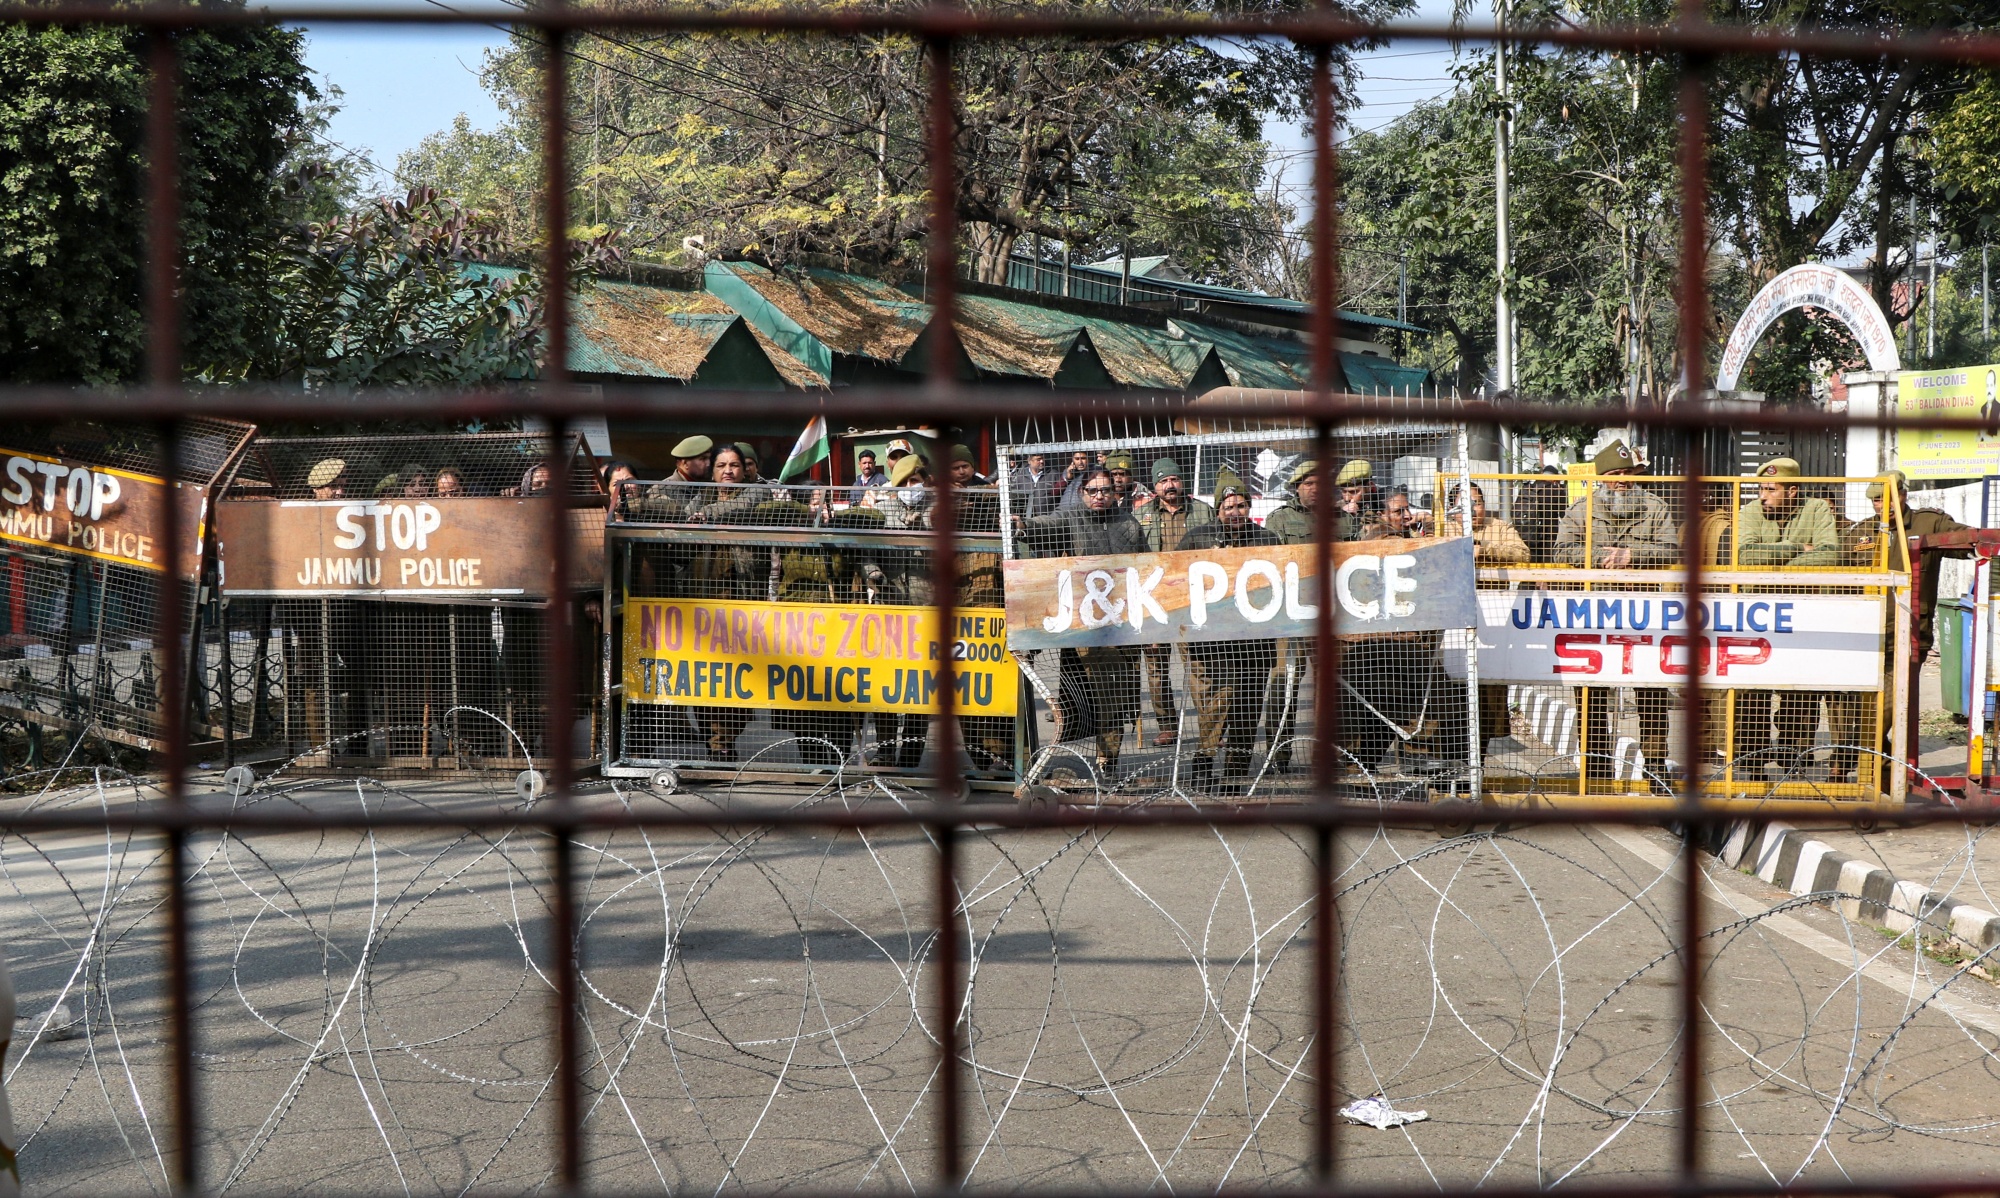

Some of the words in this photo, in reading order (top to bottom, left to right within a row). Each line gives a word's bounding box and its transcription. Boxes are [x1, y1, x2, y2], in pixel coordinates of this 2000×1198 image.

[1737, 307, 1757, 345] अमर
[1755, 289, 1772, 318] नाथ
[1913, 374, 1967, 388] WELCOME
[1919, 397, 1951, 410] BALIDAN
[1952, 396, 1974, 408] DIVAS
[1, 456, 121, 521] STOP
[0, 508, 52, 542] MMU
[67, 520, 154, 563] POLICE
[333, 504, 441, 551] STOP
[297, 557, 381, 585] JAMMU
[400, 557, 482, 586] POLICE
[1043, 566, 1168, 634] J&K
[1188, 555, 1417, 630] POLCE
[640, 604, 682, 651] NO
[693, 606, 826, 657] PARKING
[835, 612, 922, 661] ZONE
[1512, 597, 1650, 630] JAMMU
[1552, 633, 1772, 676] STOP
[639, 657, 754, 700] TRAFFIC
[767, 664, 871, 704] POLICE
[882, 668, 993, 706] JAMMU
